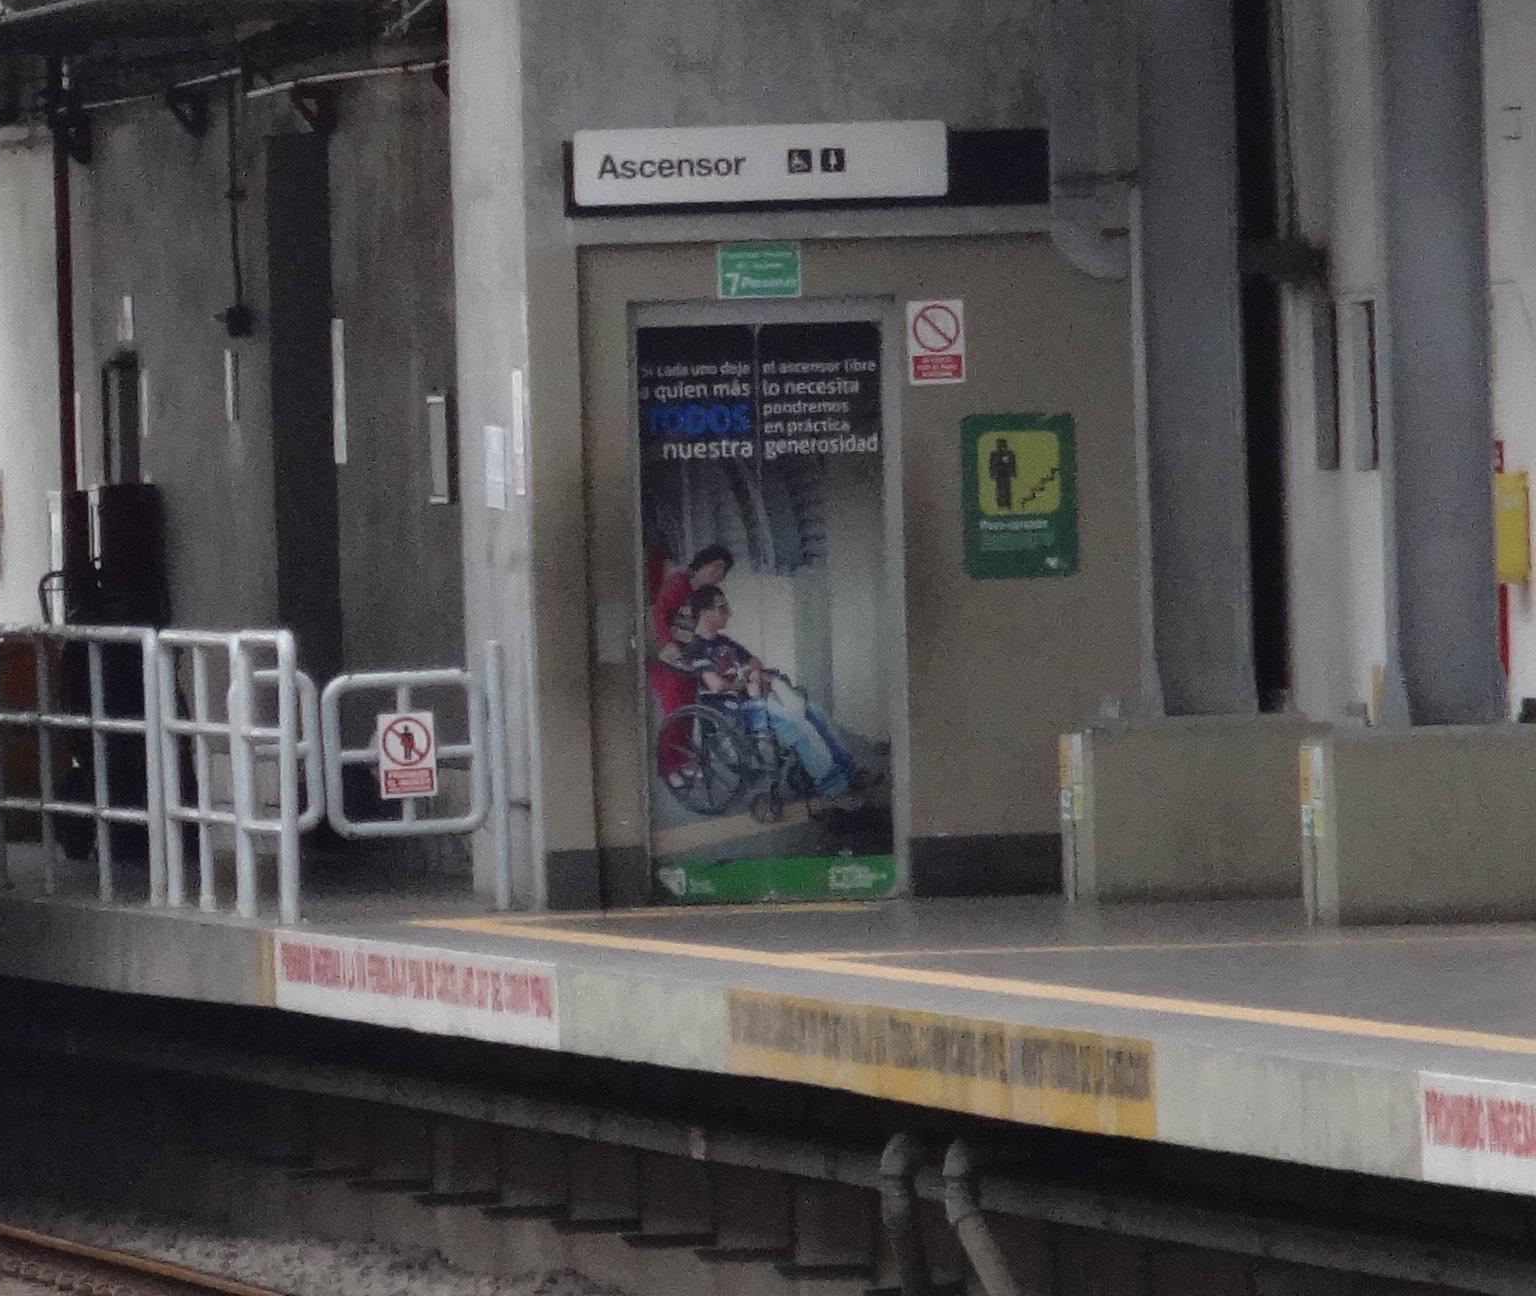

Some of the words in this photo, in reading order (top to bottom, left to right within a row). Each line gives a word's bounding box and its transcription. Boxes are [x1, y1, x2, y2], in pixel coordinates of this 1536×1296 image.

[597, 152, 747, 181] Ascensor
[654, 380, 709, 402] quien
[713, 378, 751, 397] más
[762, 379, 781, 396] lo
[784, 377, 861, 396] necesita
[662, 438, 754, 460] nuestra
[763, 433, 879, 461] generosidad
